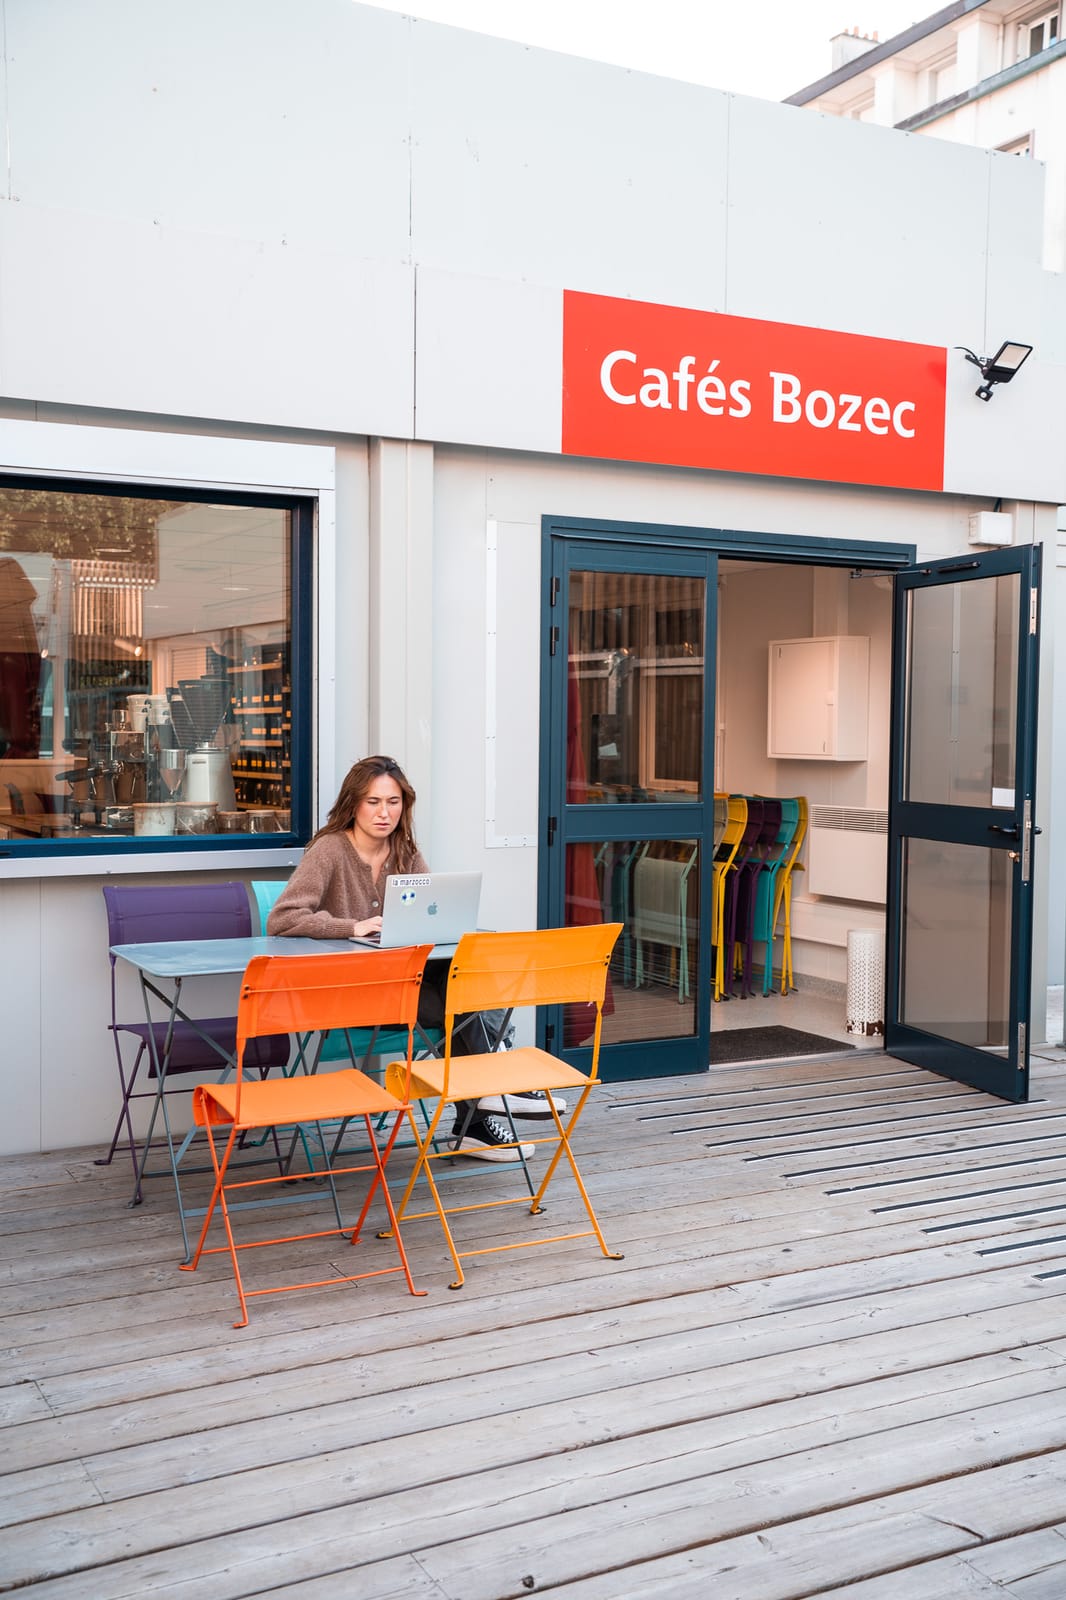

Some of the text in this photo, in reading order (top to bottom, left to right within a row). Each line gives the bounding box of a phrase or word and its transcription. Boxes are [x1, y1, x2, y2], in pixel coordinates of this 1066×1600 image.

[600, 349, 916, 438] Cafés Bozec
[399, 878, 430, 886] marzocco
